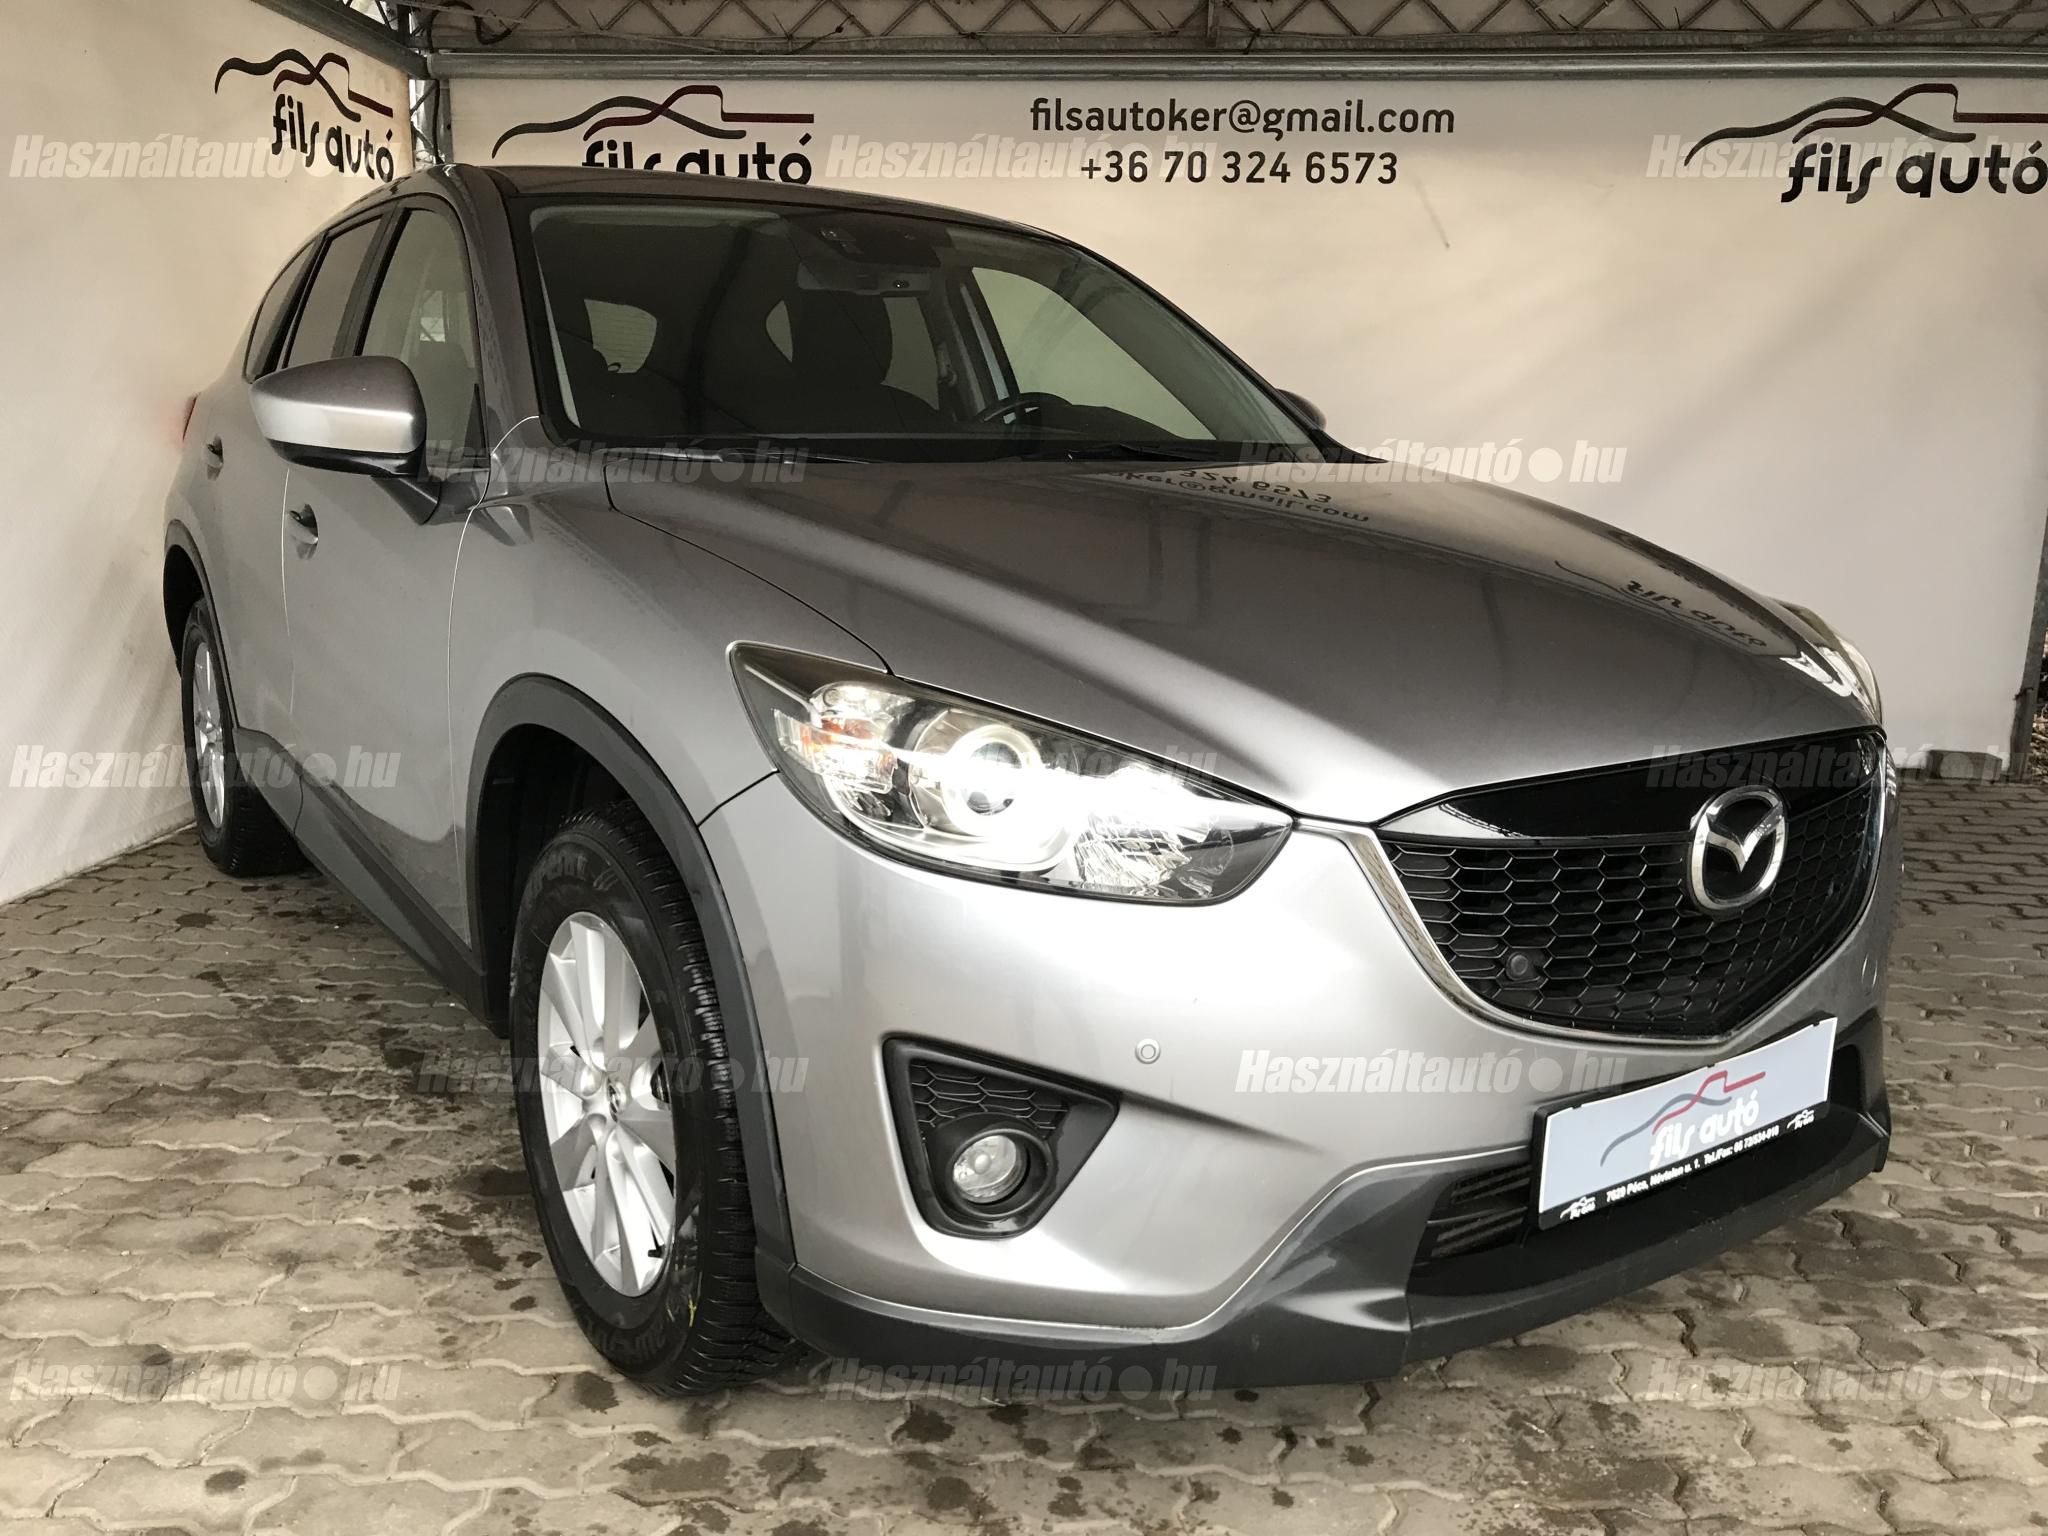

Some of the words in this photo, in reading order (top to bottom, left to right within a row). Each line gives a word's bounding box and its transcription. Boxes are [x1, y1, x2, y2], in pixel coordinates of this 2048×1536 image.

[272, 94, 319, 168] fils
[325, 125, 394, 183] autó
[1030, 99, 1456, 142] filsautoker@gmail.com
[1081, 151, 1148, 184] +36
[1164, 151, 1208, 184] 70
[1222, 151, 1290, 184] 324
[1305, 151, 1397, 184] 6573
[1781, 142, 1882, 203] fils
[1896, 140, 2048, 198] autó
[1649, 1122, 1696, 1170] fils
[1700, 1089, 1760, 1144] autó
